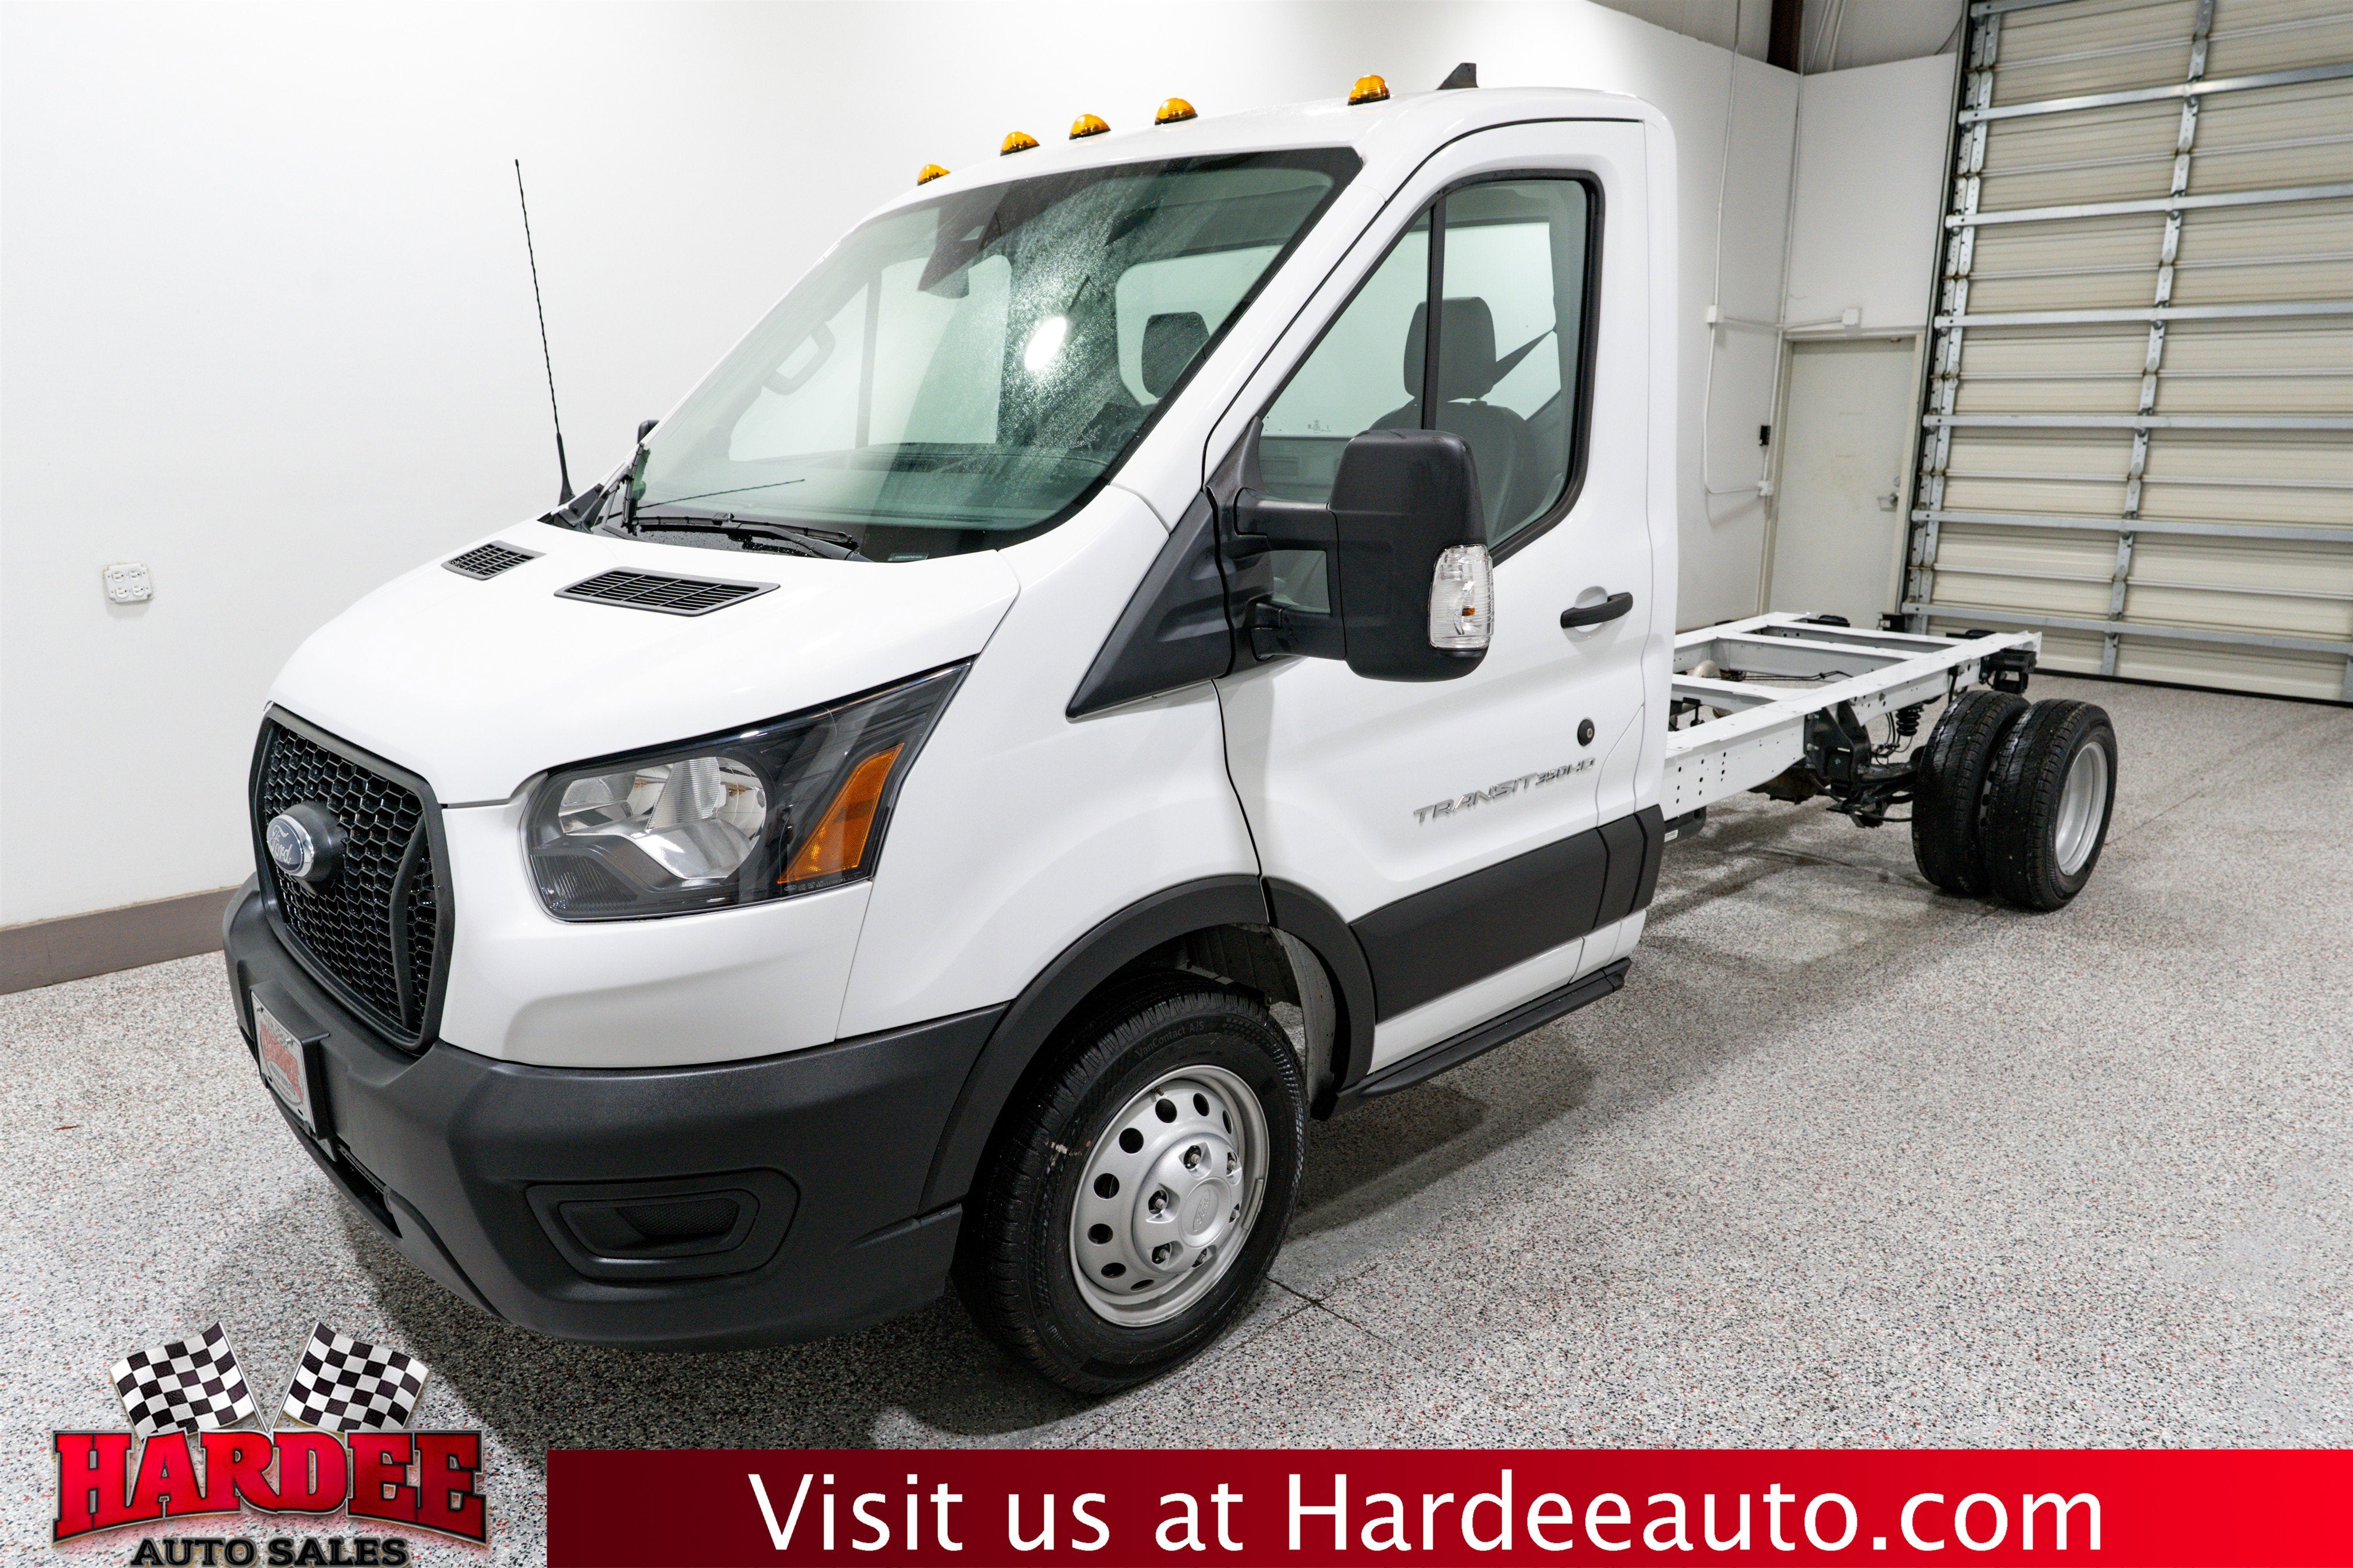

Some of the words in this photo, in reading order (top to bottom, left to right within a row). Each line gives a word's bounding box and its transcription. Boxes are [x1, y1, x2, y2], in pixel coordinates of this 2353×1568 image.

[1413, 772, 1537, 825] TRANSIT
[1536, 757, 1596, 786] 350HD
[270, 825, 293, 864] Ford
[1134, 1026, 1186, 1057] VanContact
[1189, 1021, 1205, 1033] A/S
